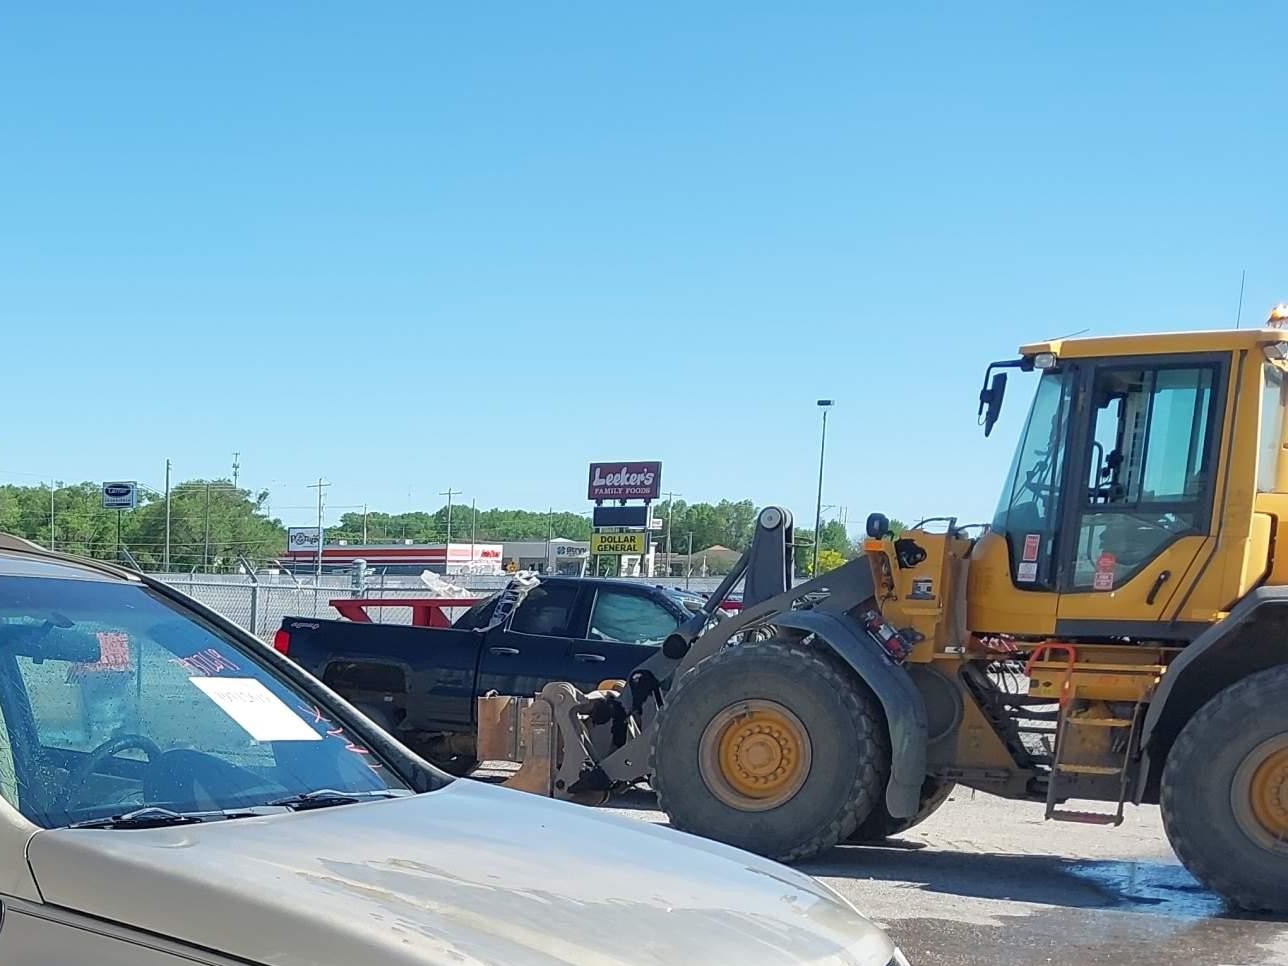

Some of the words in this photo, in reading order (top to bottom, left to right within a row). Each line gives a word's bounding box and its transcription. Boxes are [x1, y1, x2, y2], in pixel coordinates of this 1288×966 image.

[593, 467, 654, 486] Leeker's
[600, 535, 636, 543] DOLLAR
[597, 544, 638, 552] GENERAL
